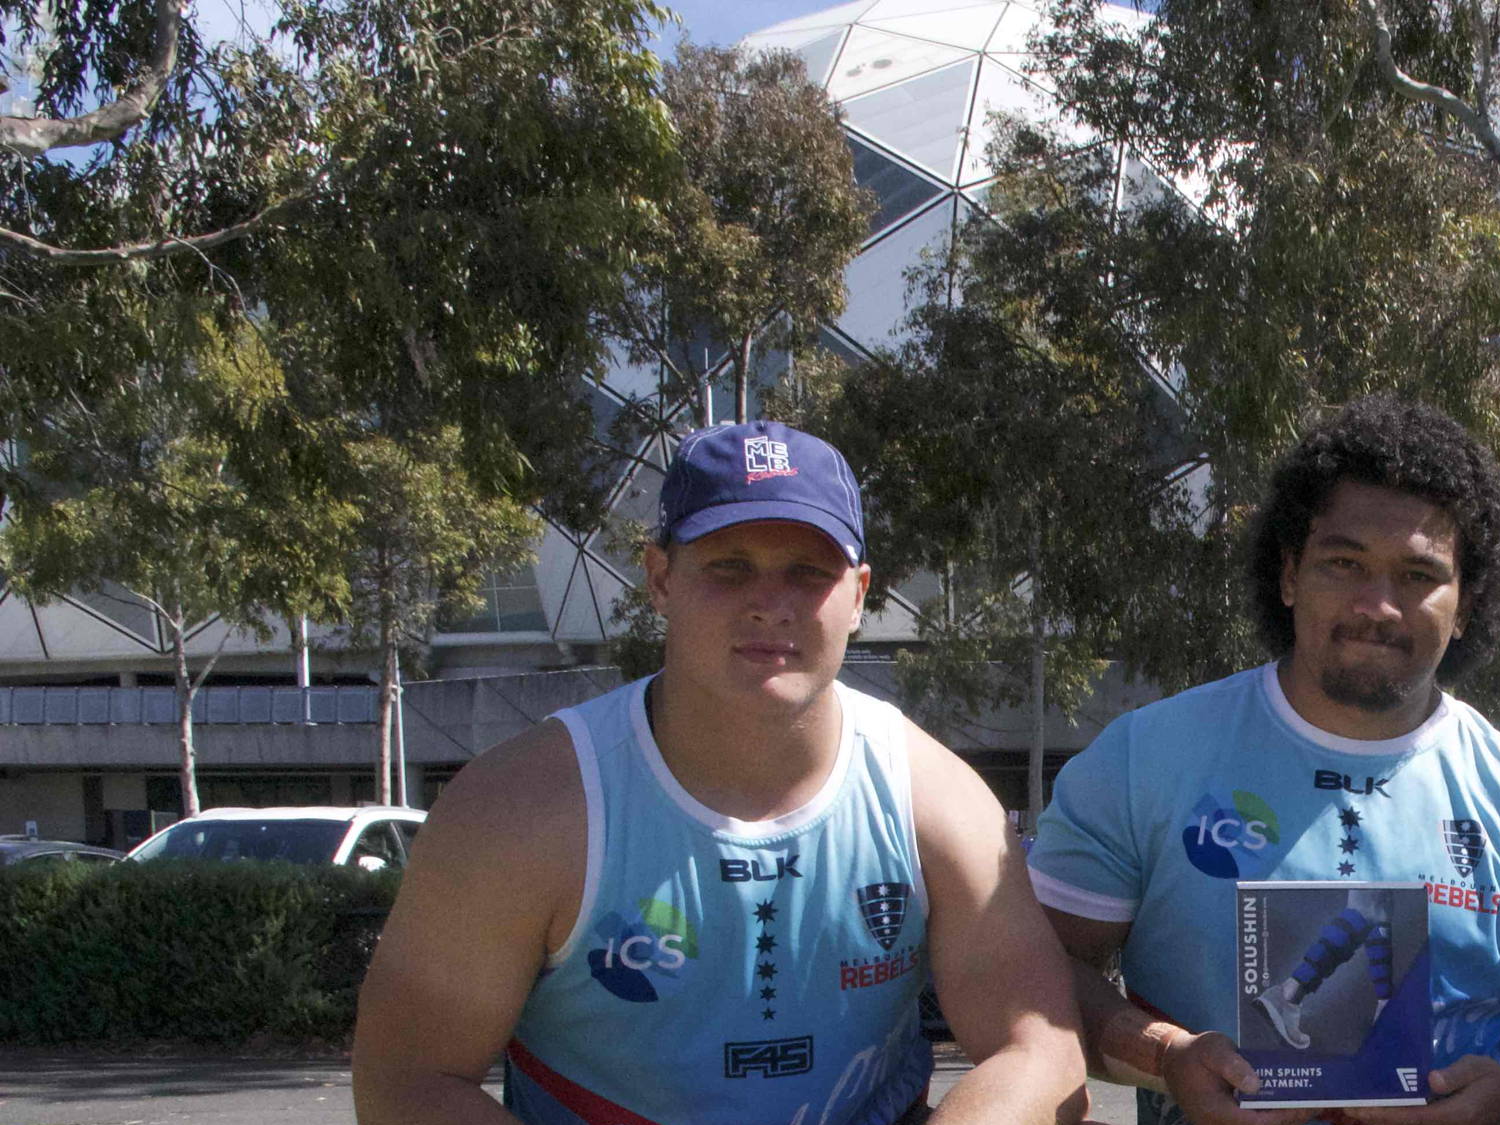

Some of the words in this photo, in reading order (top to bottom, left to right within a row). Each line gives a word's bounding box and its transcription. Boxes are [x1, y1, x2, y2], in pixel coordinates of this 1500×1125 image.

[1314, 770, 1391, 799] BLK
[1198, 815, 1268, 850] ICS
[720, 855, 803, 882] BLK
[1418, 874, 1497, 892] MELBOURN
[604, 934, 686, 970] ICS
[1243, 897, 1258, 995] SOLUSHIN
[840, 951, 921, 991] REBELS
[725, 1035, 813, 1079] F45
[1255, 1067, 1273, 1077] HIN
[1277, 1067, 1322, 1077] SPLINTS
[1258, 1078, 1313, 1089] EATMENT.
